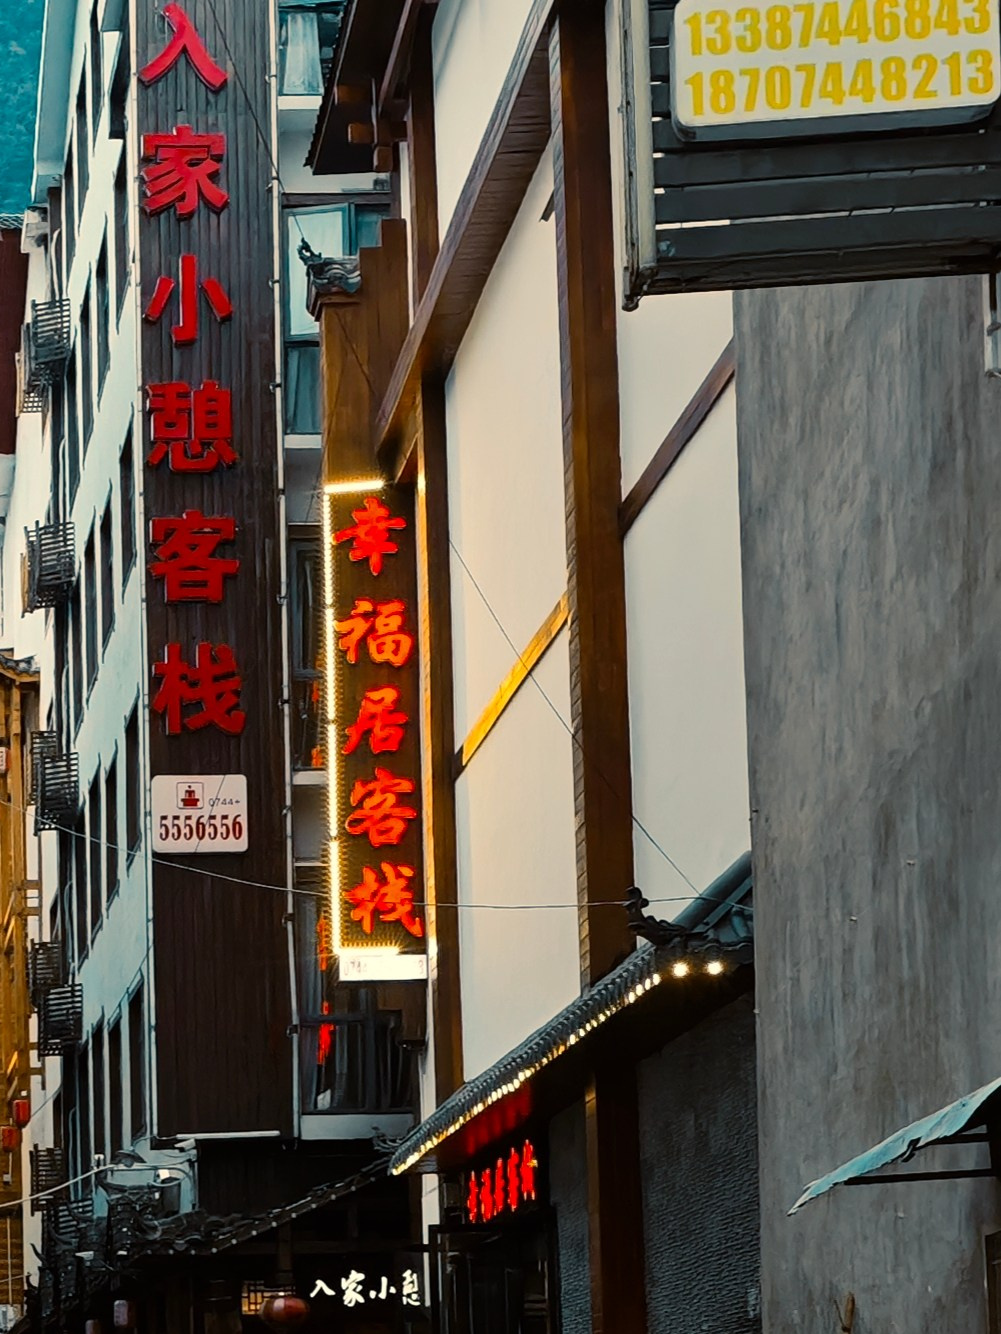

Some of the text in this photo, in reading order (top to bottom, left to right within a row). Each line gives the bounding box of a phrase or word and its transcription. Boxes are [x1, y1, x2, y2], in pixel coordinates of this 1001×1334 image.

[684, 0, 991, 56] 13387446843
[684, 49, 994, 117] 18707448213
[138, 2, 246, 736] 入家小憩客栈
[332, 496, 425, 938] 幸福居客栈
[159, 814, 243, 841] 5556556
